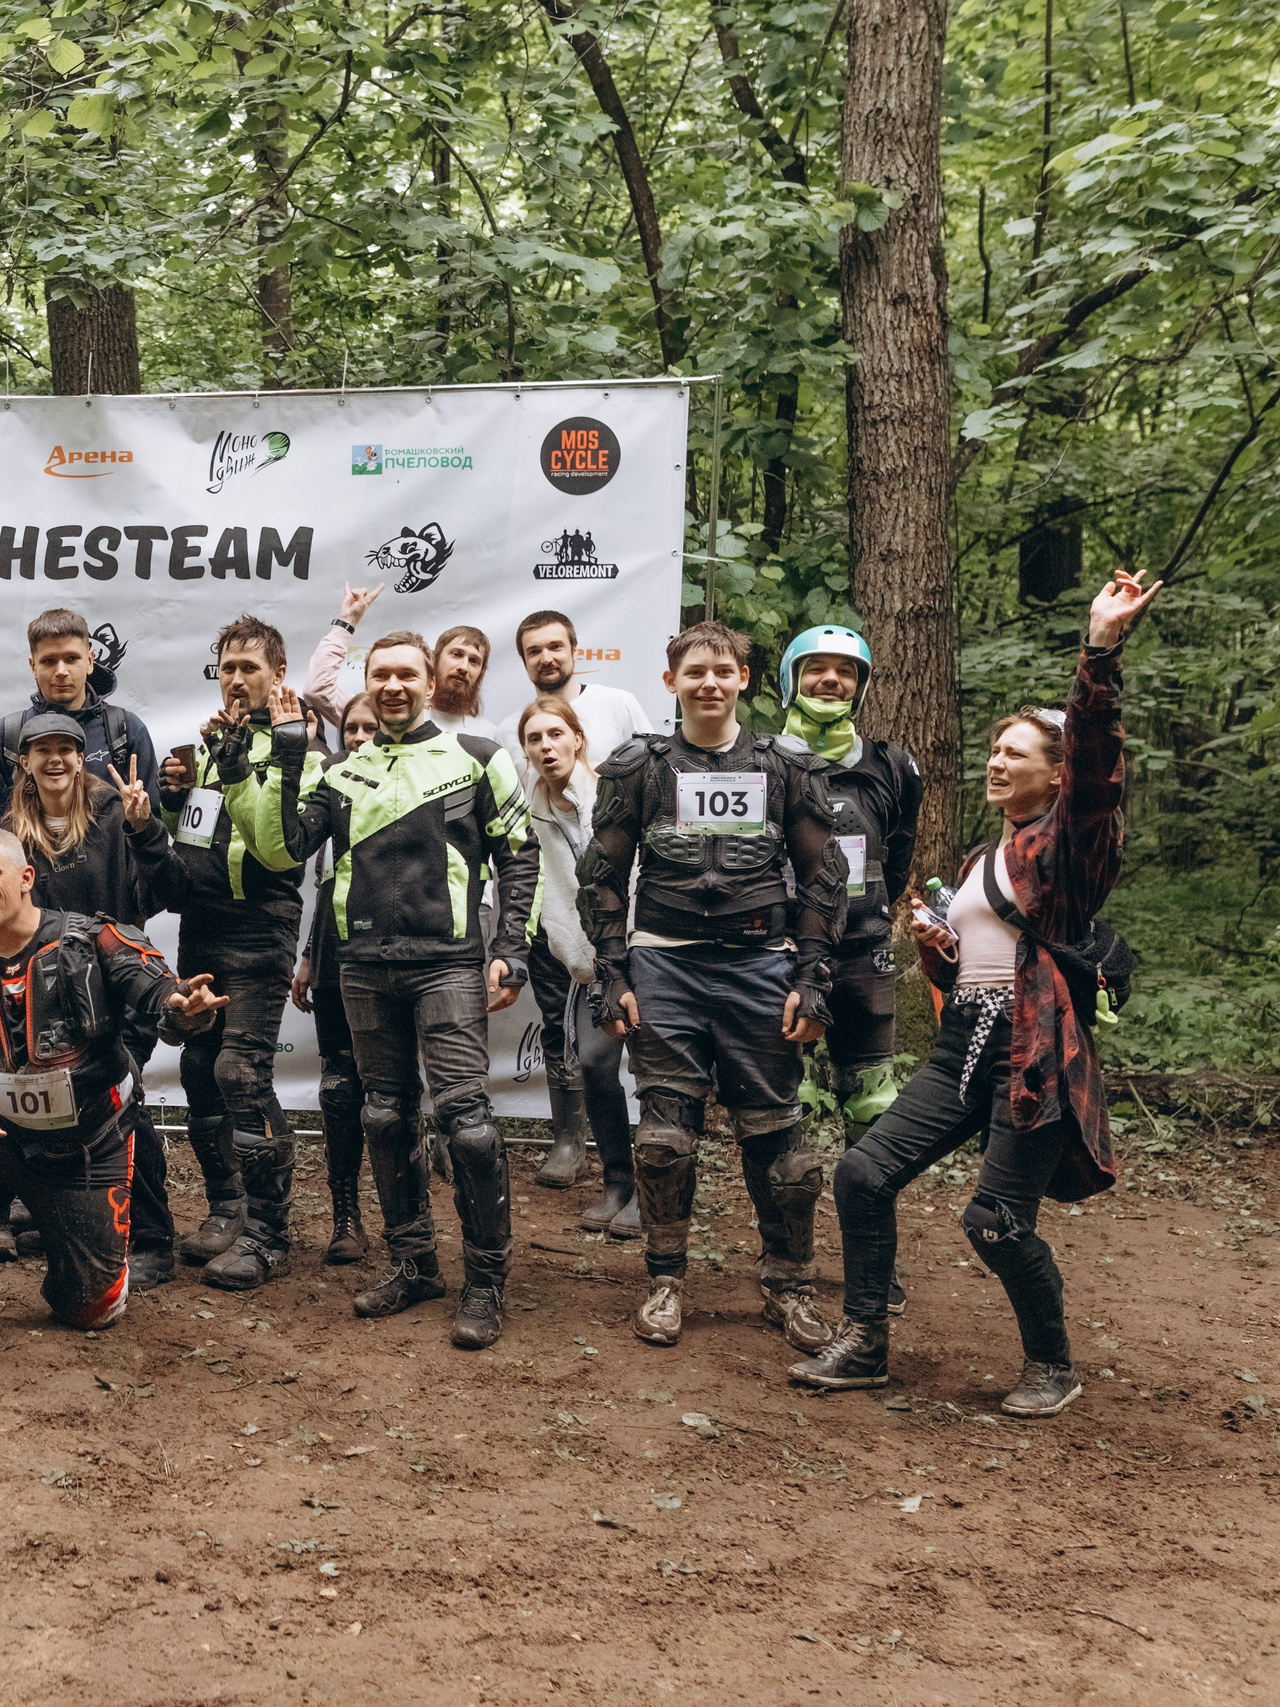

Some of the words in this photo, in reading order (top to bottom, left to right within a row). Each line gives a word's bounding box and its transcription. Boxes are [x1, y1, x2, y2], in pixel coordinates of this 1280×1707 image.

[561, 430, 599, 449] MOS
[46, 445, 133, 465] Арена
[384, 445, 464, 456] РОМАШКОВСКИЙ
[551, 450, 609, 469] CYCLE
[384, 456, 473, 470] ПЧЕЛОВОД
[538, 564, 614, 578] VELOREMONT
[422, 774, 471, 798] SCOYCO
[695, 791, 748, 817] 103
[54, 862, 76, 873] clown
[6, 1090, 51, 1115] 101
